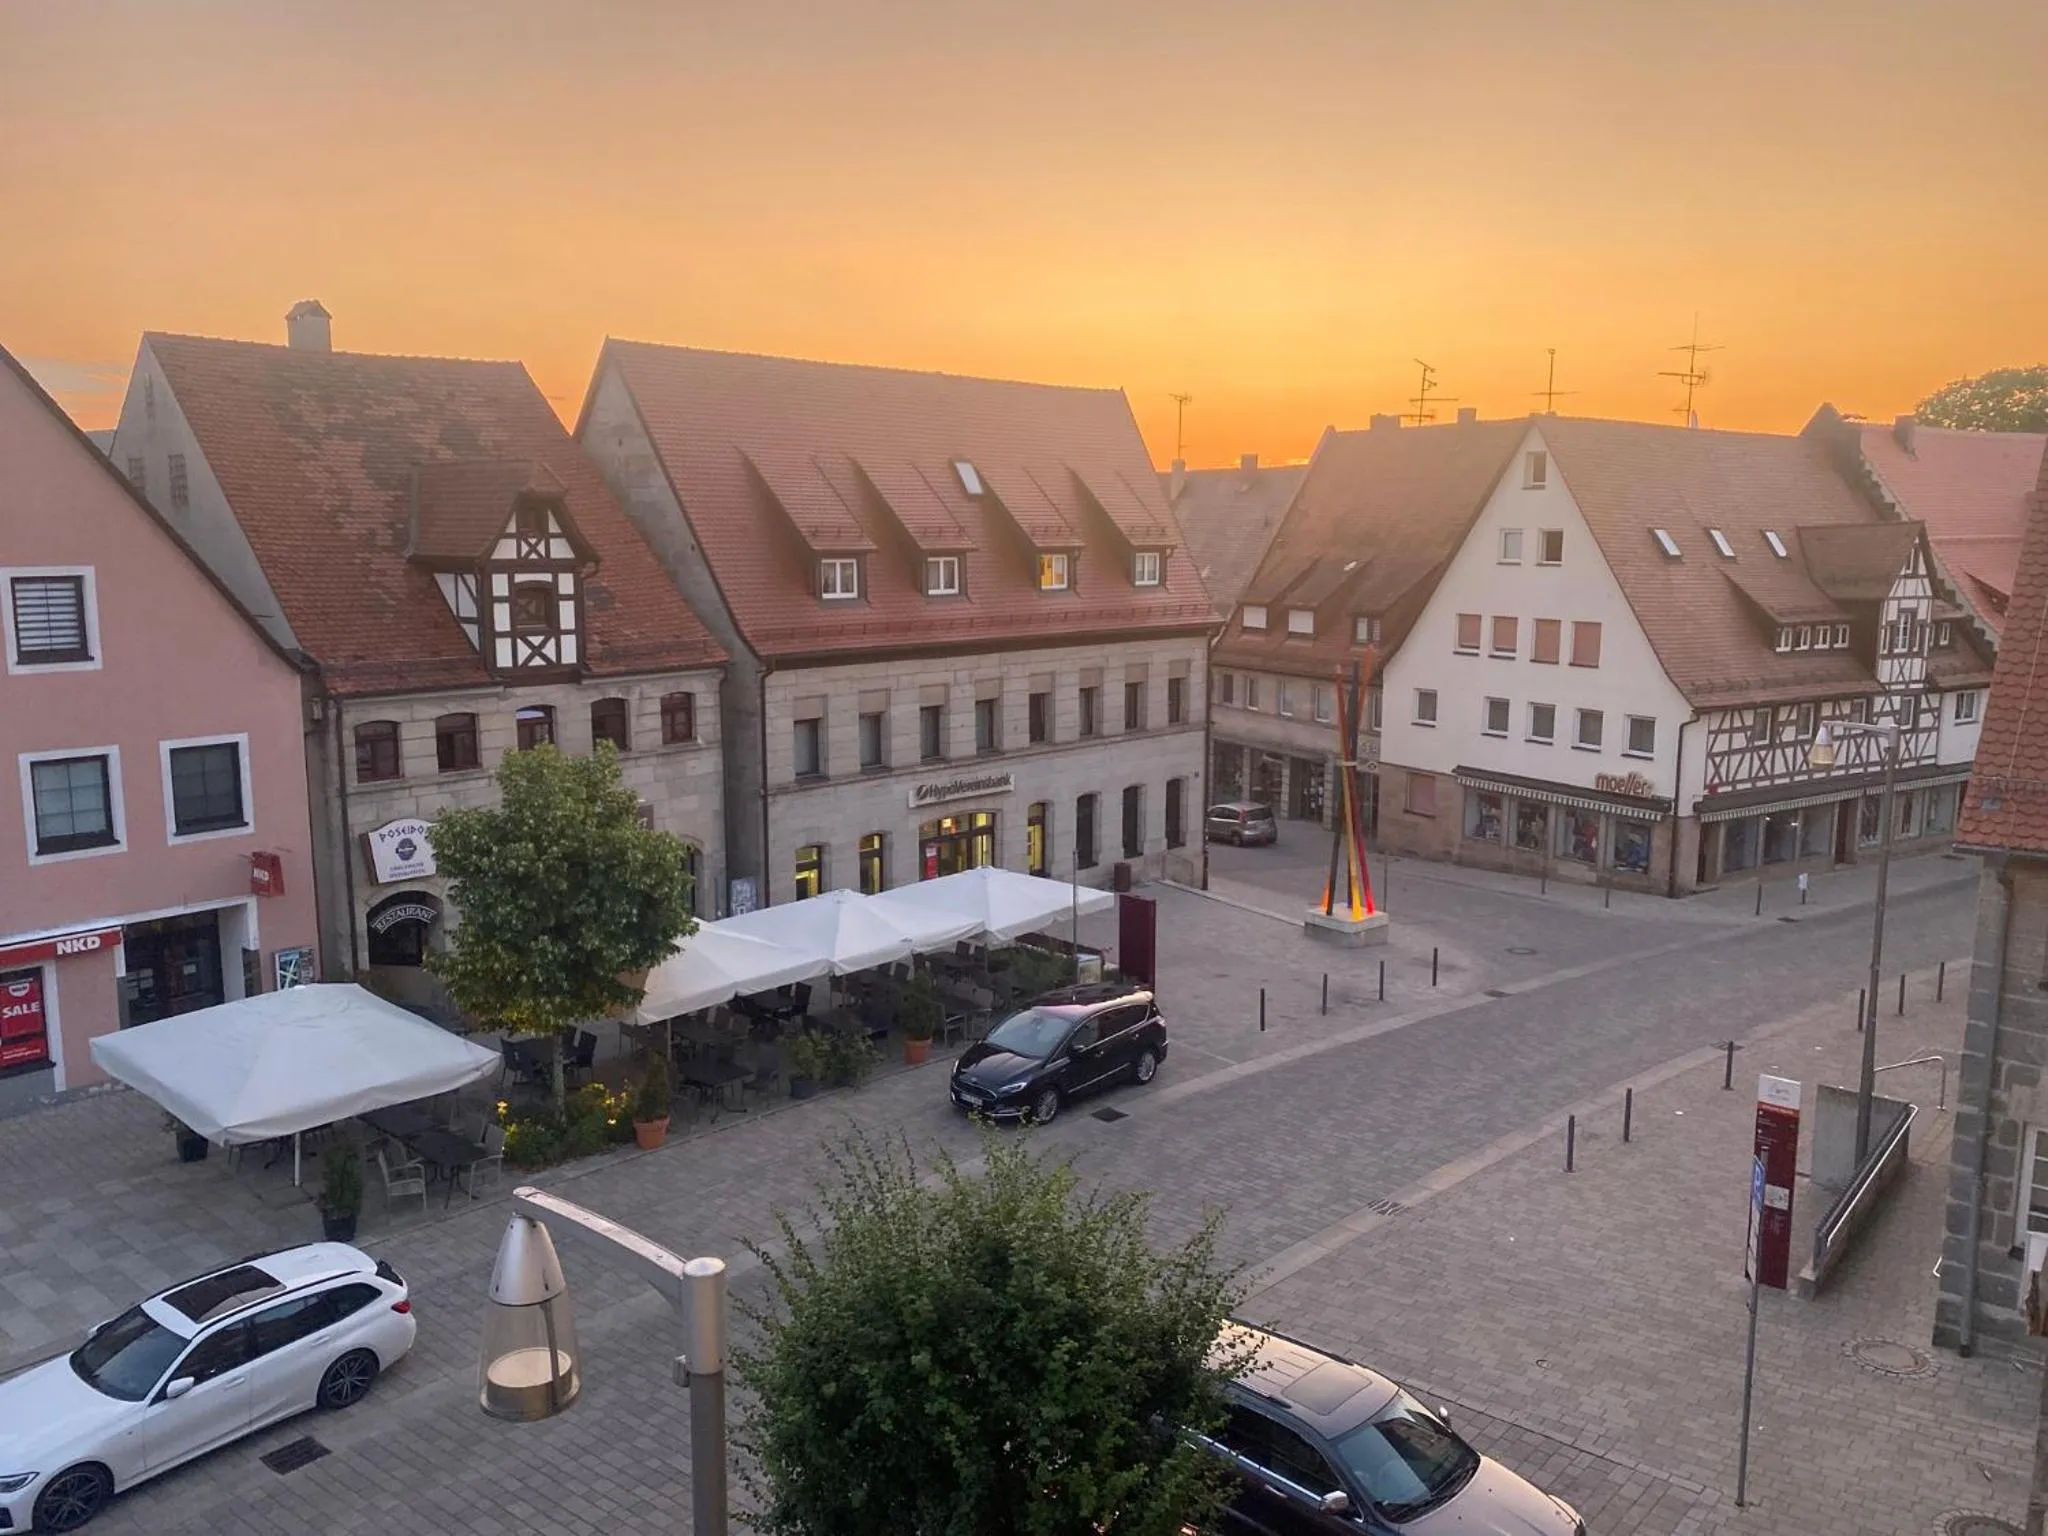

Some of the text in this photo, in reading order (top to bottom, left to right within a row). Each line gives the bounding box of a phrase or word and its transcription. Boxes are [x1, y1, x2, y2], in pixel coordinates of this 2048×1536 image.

[376, 906, 435, 930] RESTAURANT
[56, 936, 101, 955] NKD
[2, 1001, 41, 1019] SALE
